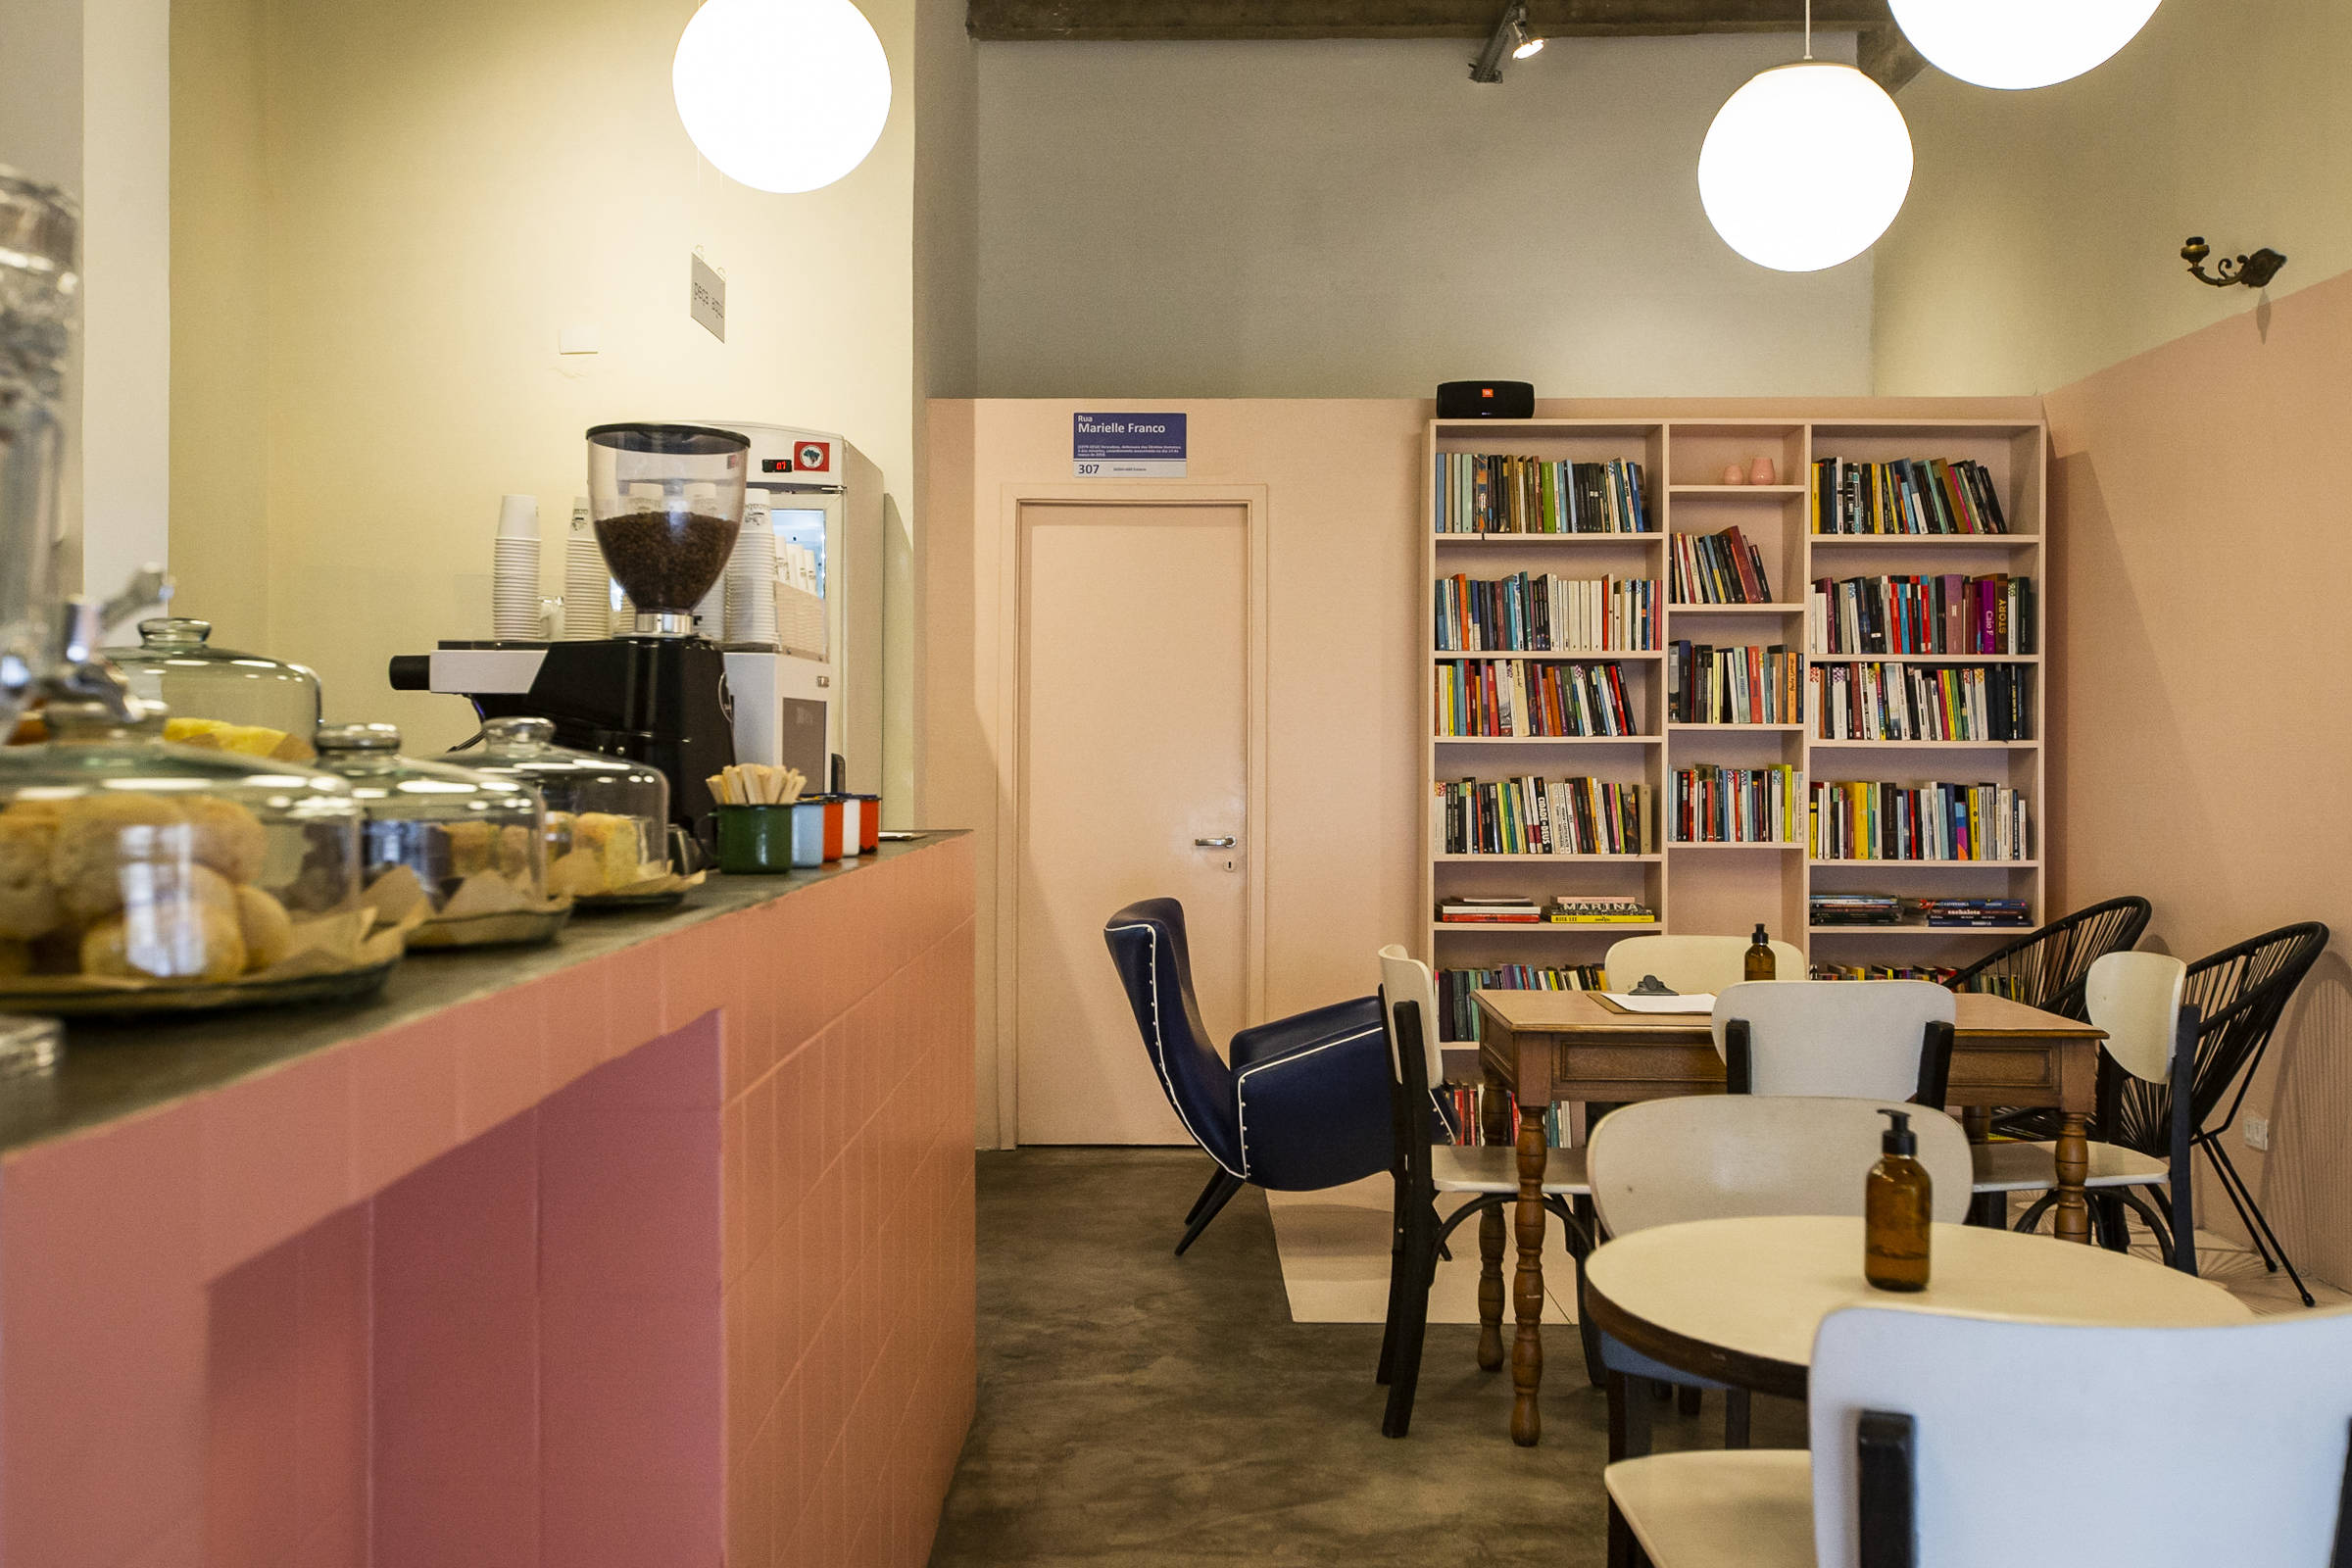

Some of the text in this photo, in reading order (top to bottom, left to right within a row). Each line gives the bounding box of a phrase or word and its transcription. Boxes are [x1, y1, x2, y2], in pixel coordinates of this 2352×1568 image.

[1078, 422, 1166, 433] Marielle Franco
[1078, 464, 1100, 474] 307
[1998, 599, 2007, 635] STORY
[1538, 796, 1551, 845] CIDADE DEUS
[1563, 902, 1640, 912] MARINA
